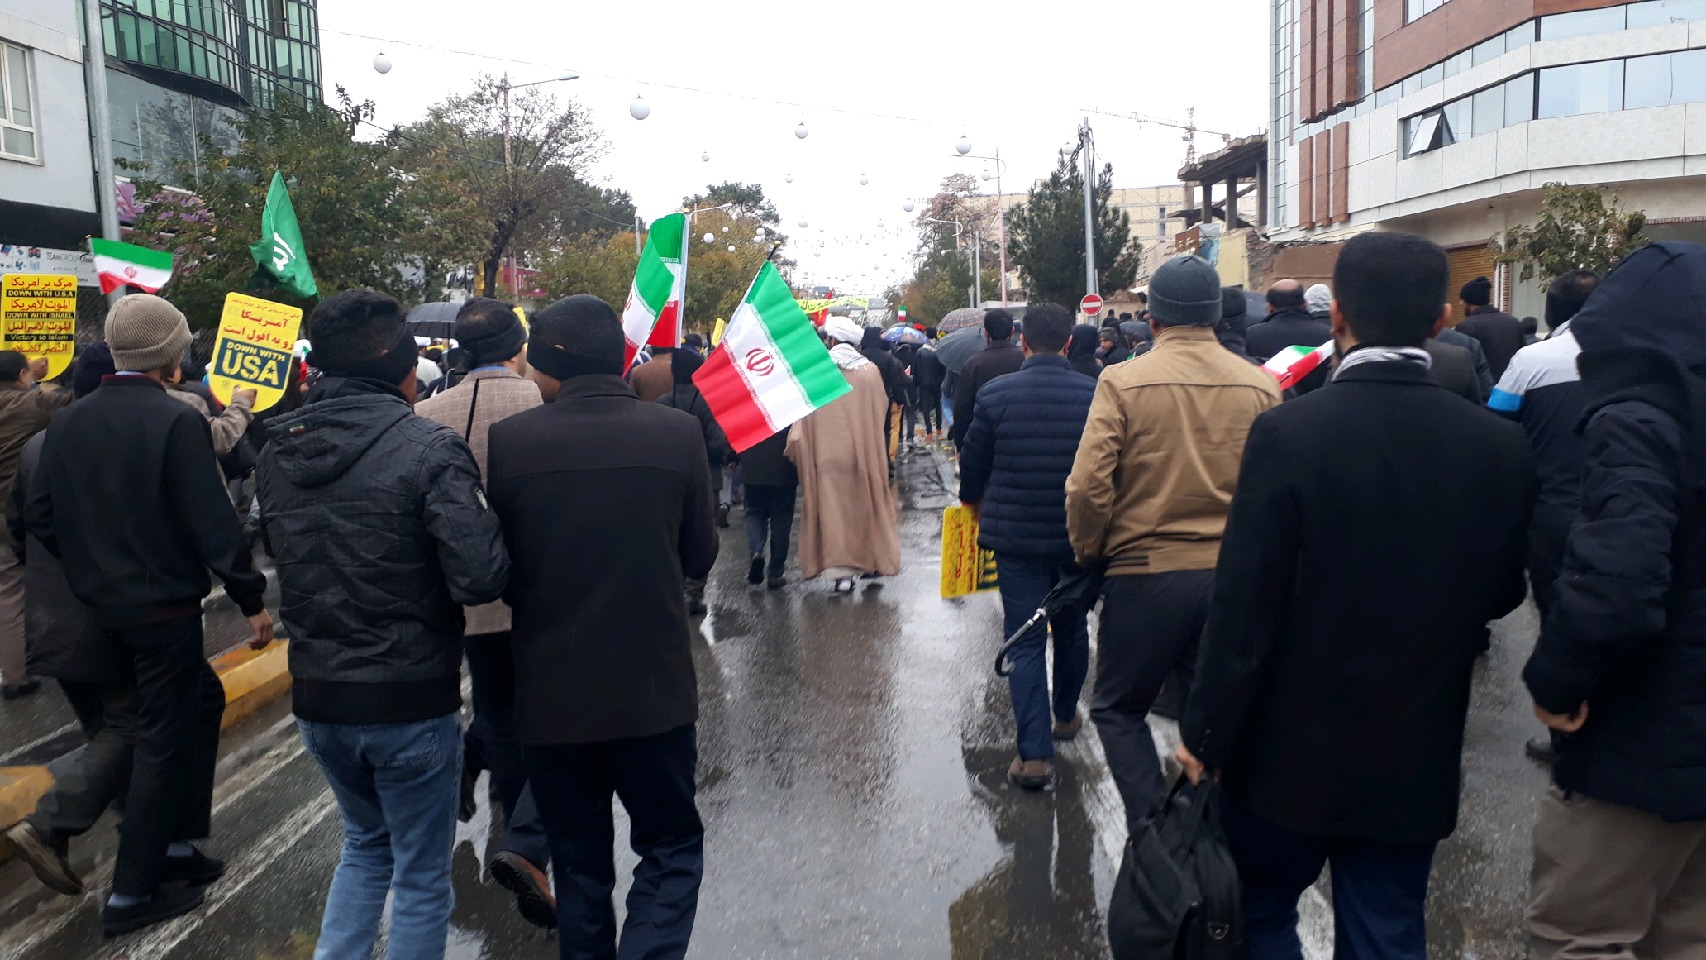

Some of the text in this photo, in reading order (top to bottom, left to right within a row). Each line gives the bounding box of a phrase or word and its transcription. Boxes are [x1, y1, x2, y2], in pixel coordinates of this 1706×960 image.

[41, 281, 51, 290] بر
[223, 325, 246, 336] است
[226, 341, 286, 362] DOWN WITH
[222, 349, 280, 386] USA
